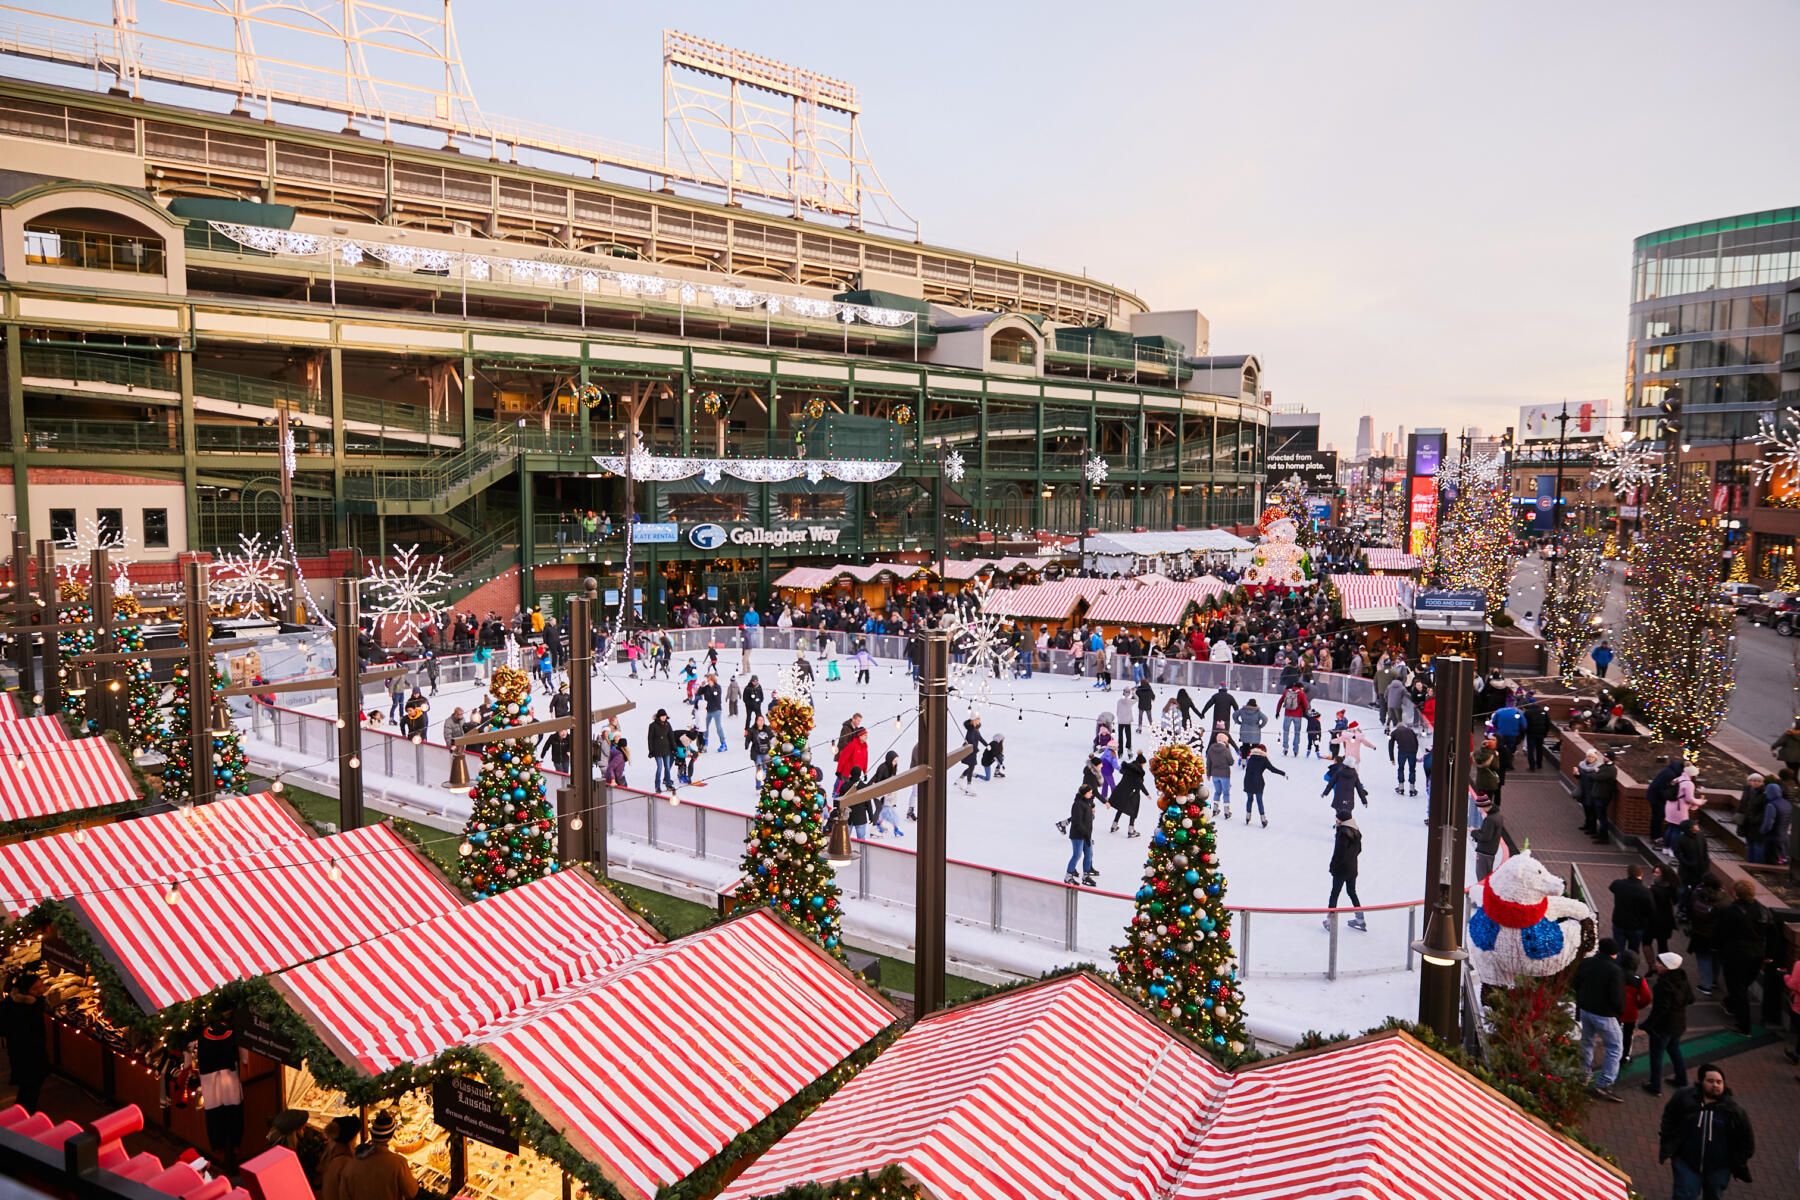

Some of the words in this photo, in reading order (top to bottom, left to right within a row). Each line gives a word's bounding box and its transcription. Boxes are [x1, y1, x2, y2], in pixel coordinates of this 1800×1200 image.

[1267, 462, 1277, 470] nd
[1277, 462, 1285, 470] to
[1286, 462, 1305, 470] home
[730, 527, 807, 547] Gallagher
[807, 525, 841, 545] Way
[451, 1078, 492, 1101] Glaszaube
[457, 1090, 491, 1113] Lauscha
[445, 1107, 464, 1120] German
[463, 1114, 478, 1126] Glass
